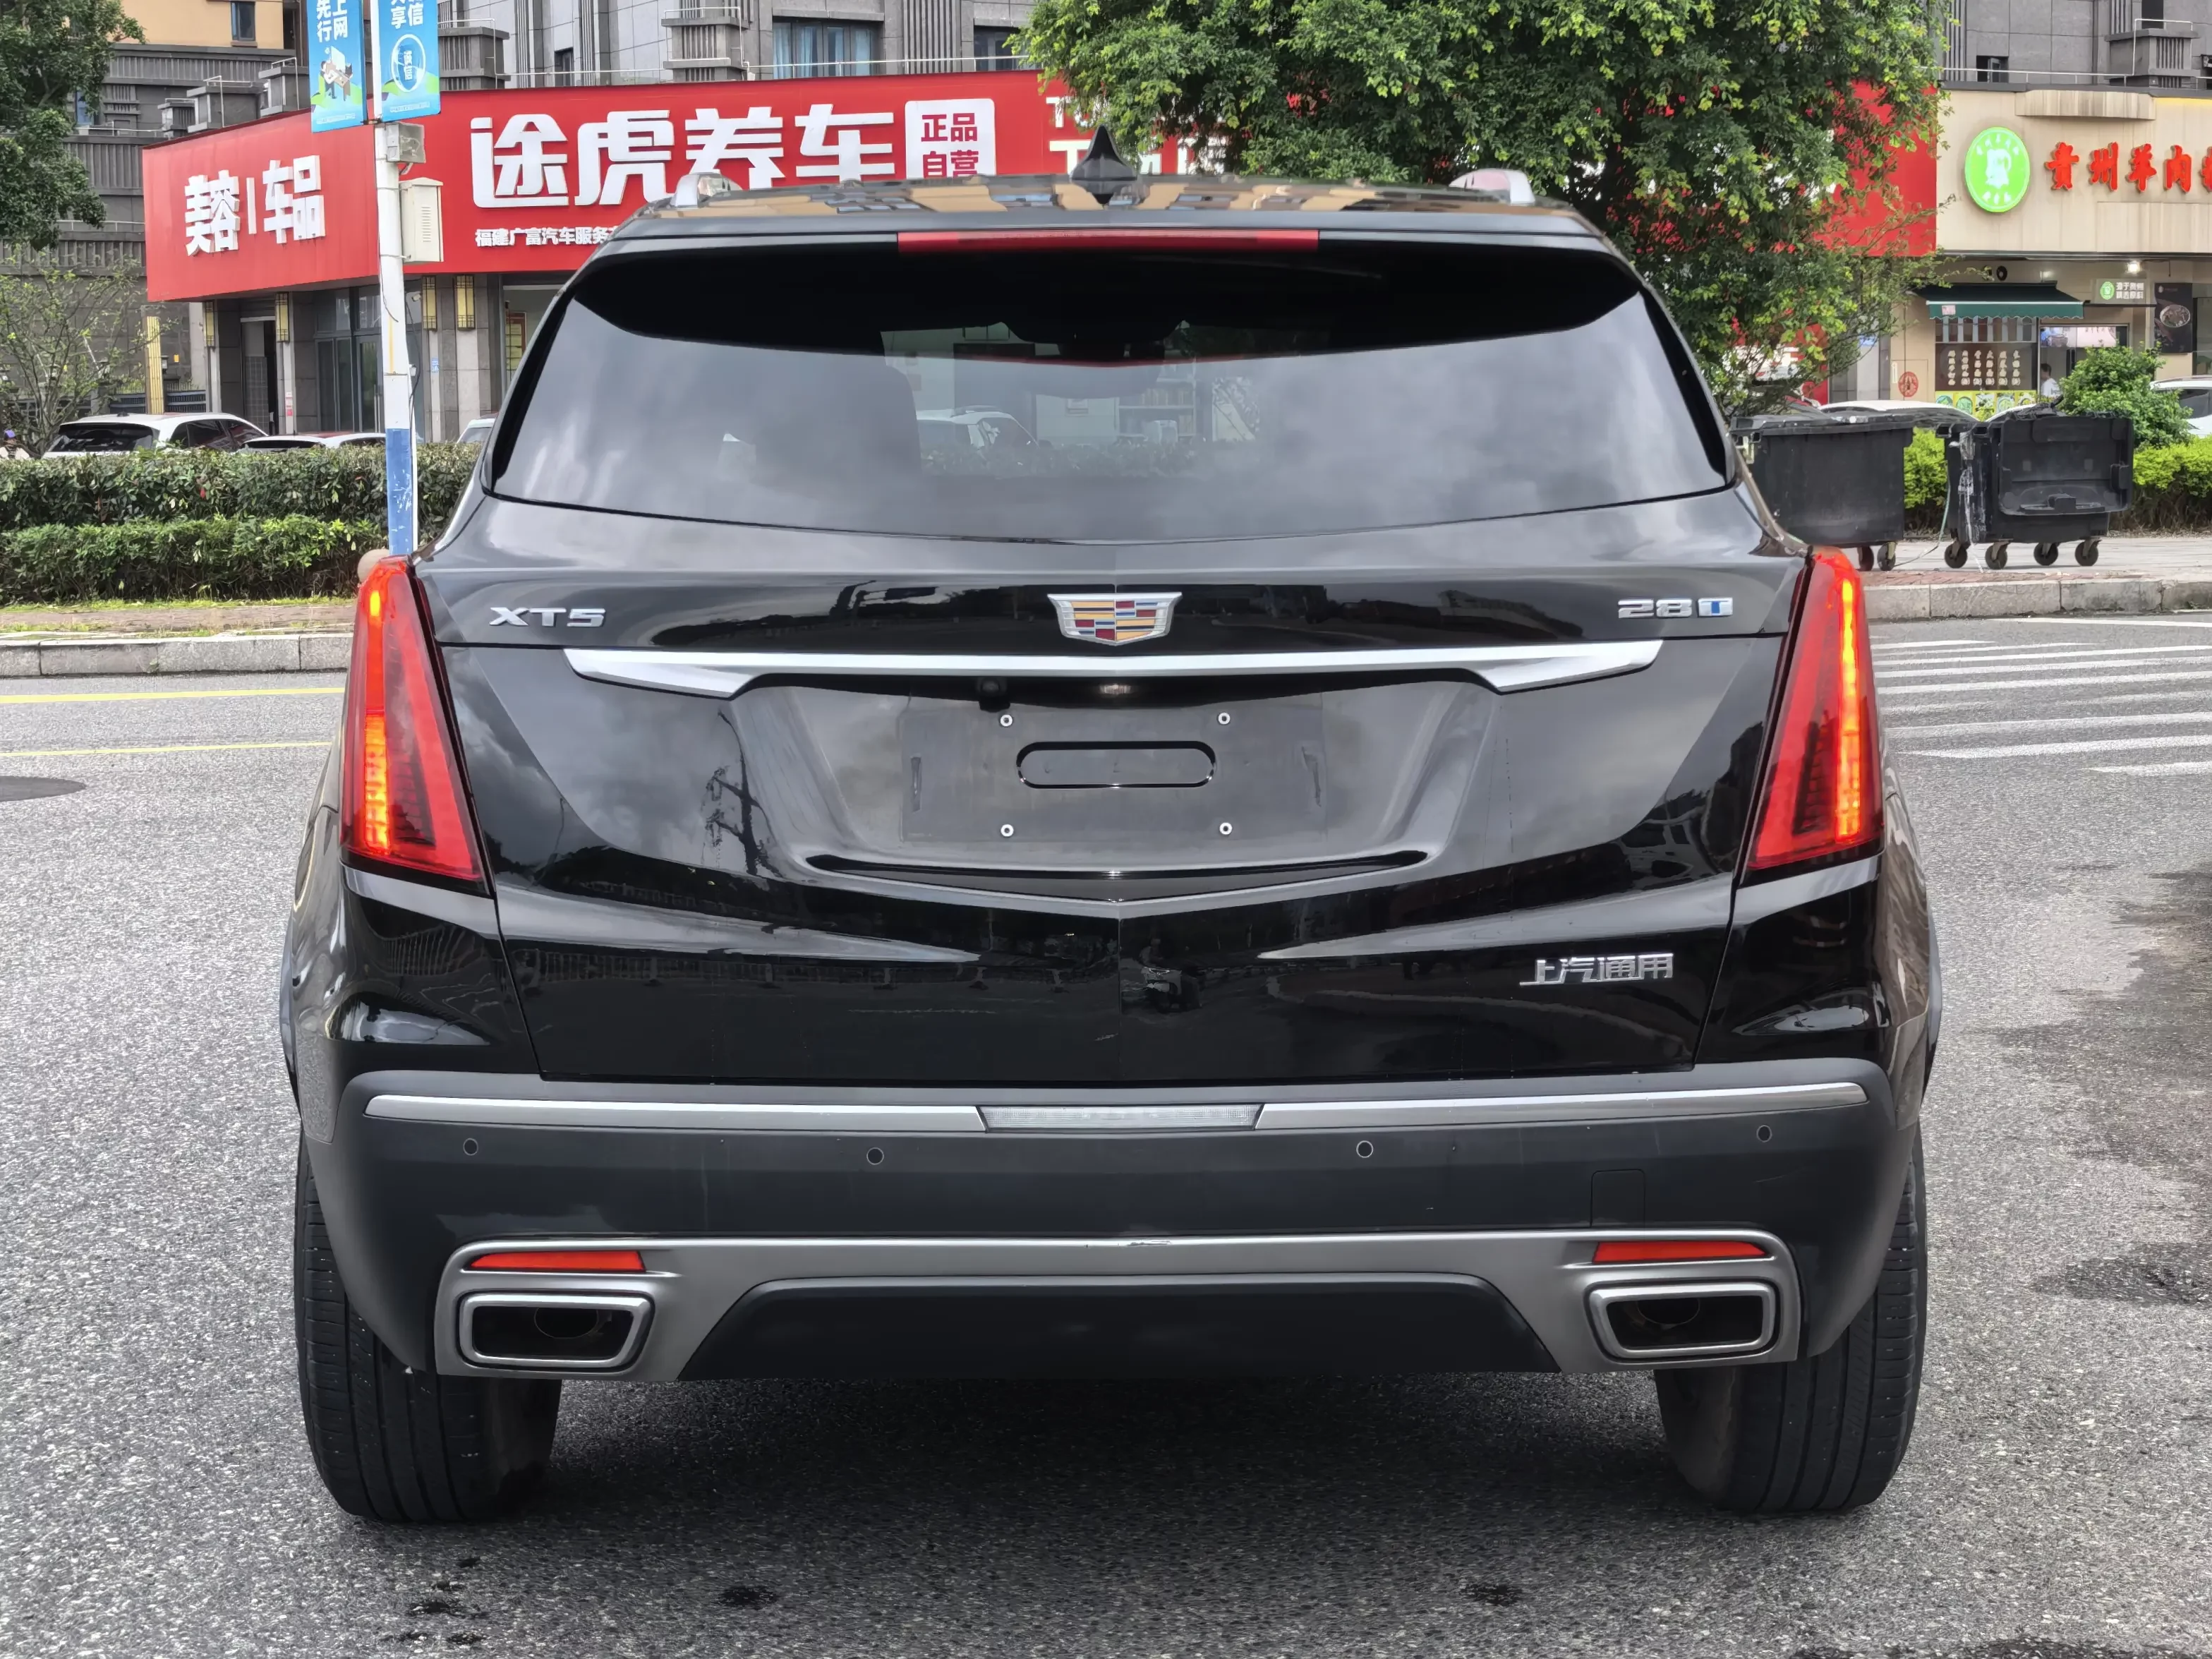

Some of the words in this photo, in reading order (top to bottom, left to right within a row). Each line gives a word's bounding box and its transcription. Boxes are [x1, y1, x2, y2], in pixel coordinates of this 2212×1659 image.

[921, 112, 978, 143] 正品
[471, 103, 895, 208] 途虎养车
[922, 149, 979, 179] 自营
[184, 169, 241, 257] 美容
[262, 155, 326, 244] 车品
[475, 226, 619, 247] 福建广富汽车服务
[489, 607, 606, 627] XT5
[1618, 597, 1734, 619] 28T
[1519, 953, 1674, 987] 上汽通用
